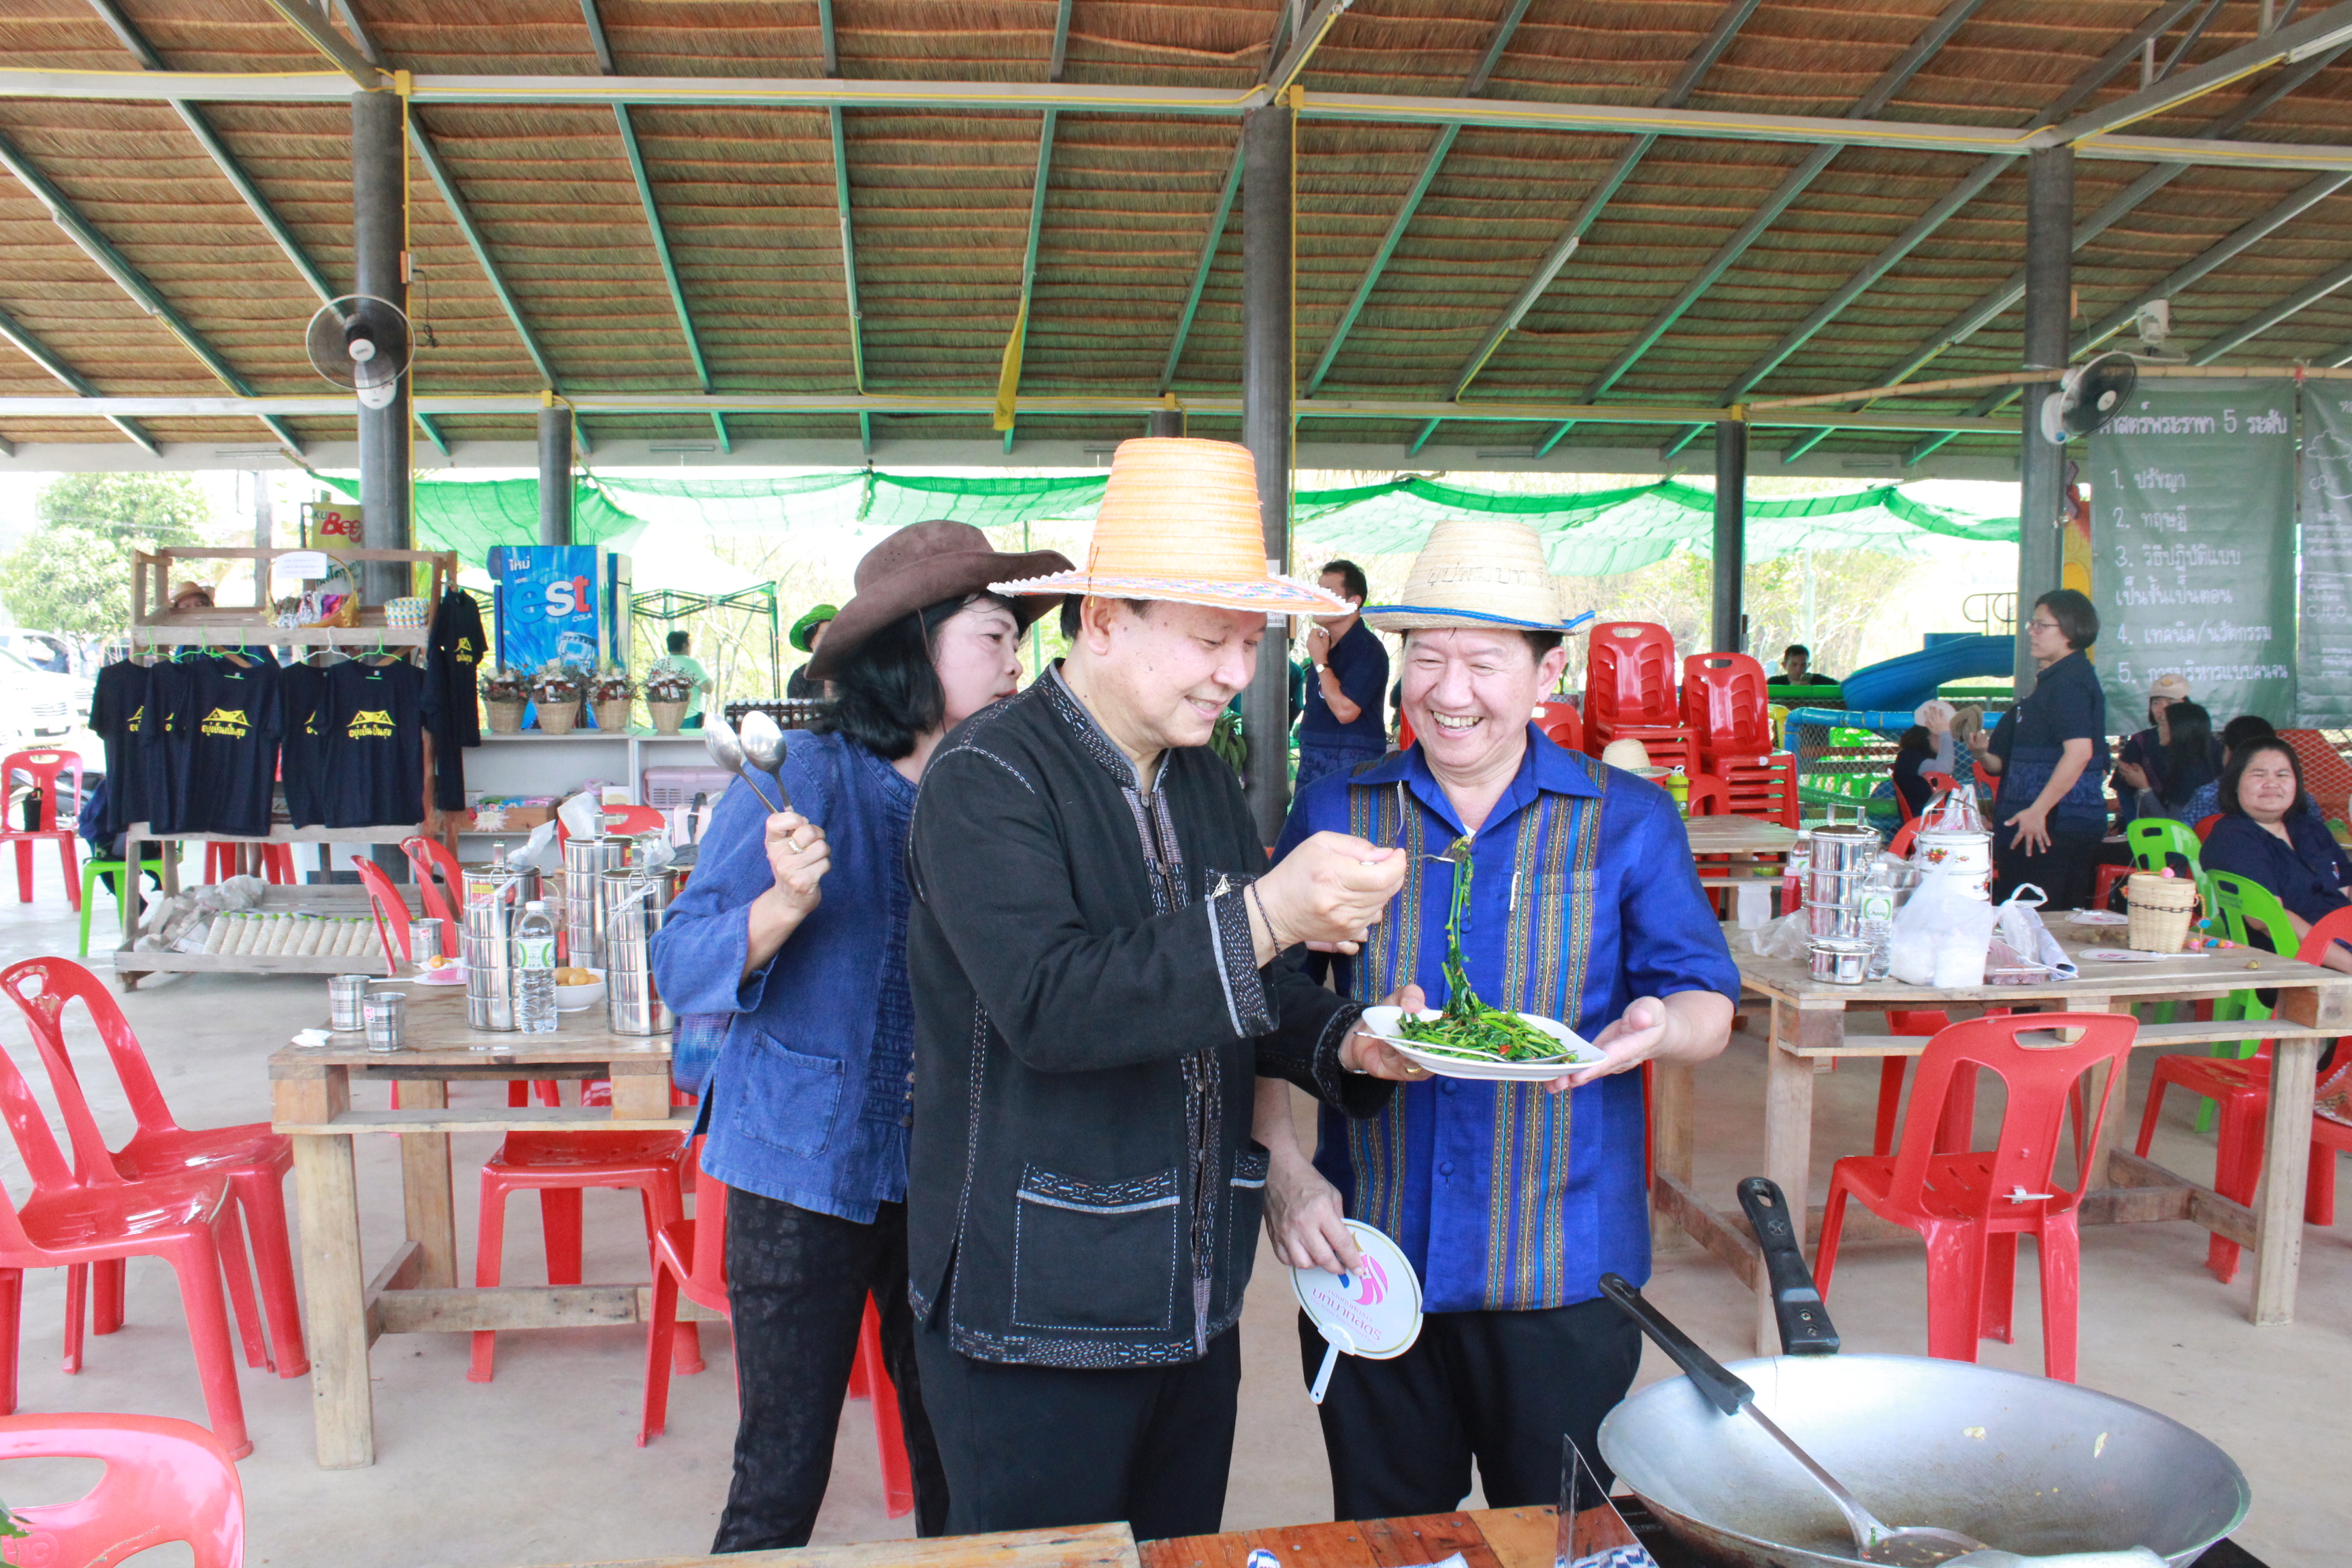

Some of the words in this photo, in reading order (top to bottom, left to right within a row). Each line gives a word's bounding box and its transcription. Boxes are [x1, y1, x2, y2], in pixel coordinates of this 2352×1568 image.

[2223, 409, 2238, 433] 5
[2247, 409, 2288, 434] ระดับ
[2110, 468, 2125, 489] 1.
[2112, 507, 2131, 529] 2.
[508, 555, 531, 572] ใหม่
[2114, 545, 2134, 568] 3.
[512, 575, 591, 624] est
[572, 612, 593, 623] COLA
[2117, 623, 2134, 645] 4.
[2118, 662, 2137, 683] 5.
[1867, 909, 1887, 917] Chang
[1312, 1288, 1383, 1341] บทบาทสตรี
